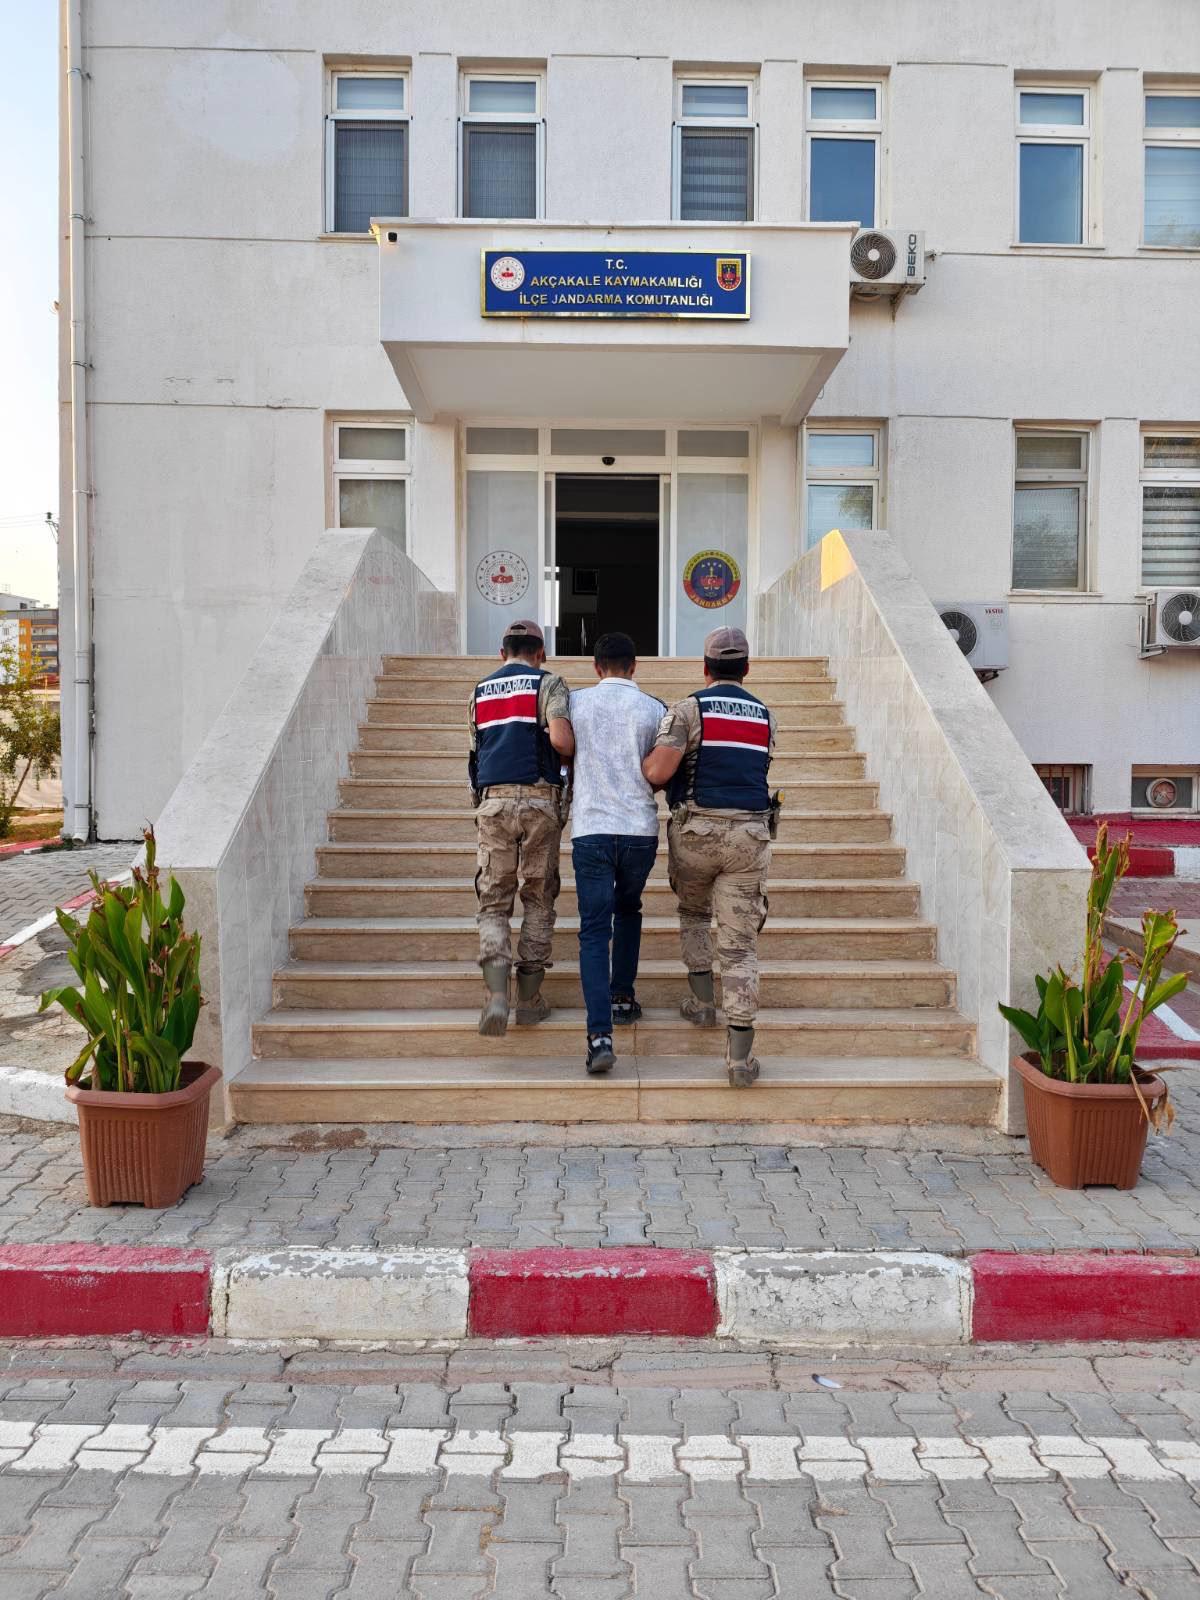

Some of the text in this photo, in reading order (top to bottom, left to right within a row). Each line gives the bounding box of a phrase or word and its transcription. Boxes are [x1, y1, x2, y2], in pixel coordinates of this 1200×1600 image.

[907, 234, 917, 276] BEKO
[605, 259, 628, 270] T.C.
[530, 275, 702, 288] AKÇAKALE KAYMAKAMLIĞI
[519, 291, 713, 306] İLÇE JANDARMA KOMUTANLIĞI
[480, 679, 533, 697] JANDARMA
[708, 700, 764, 720] JANDARMA
